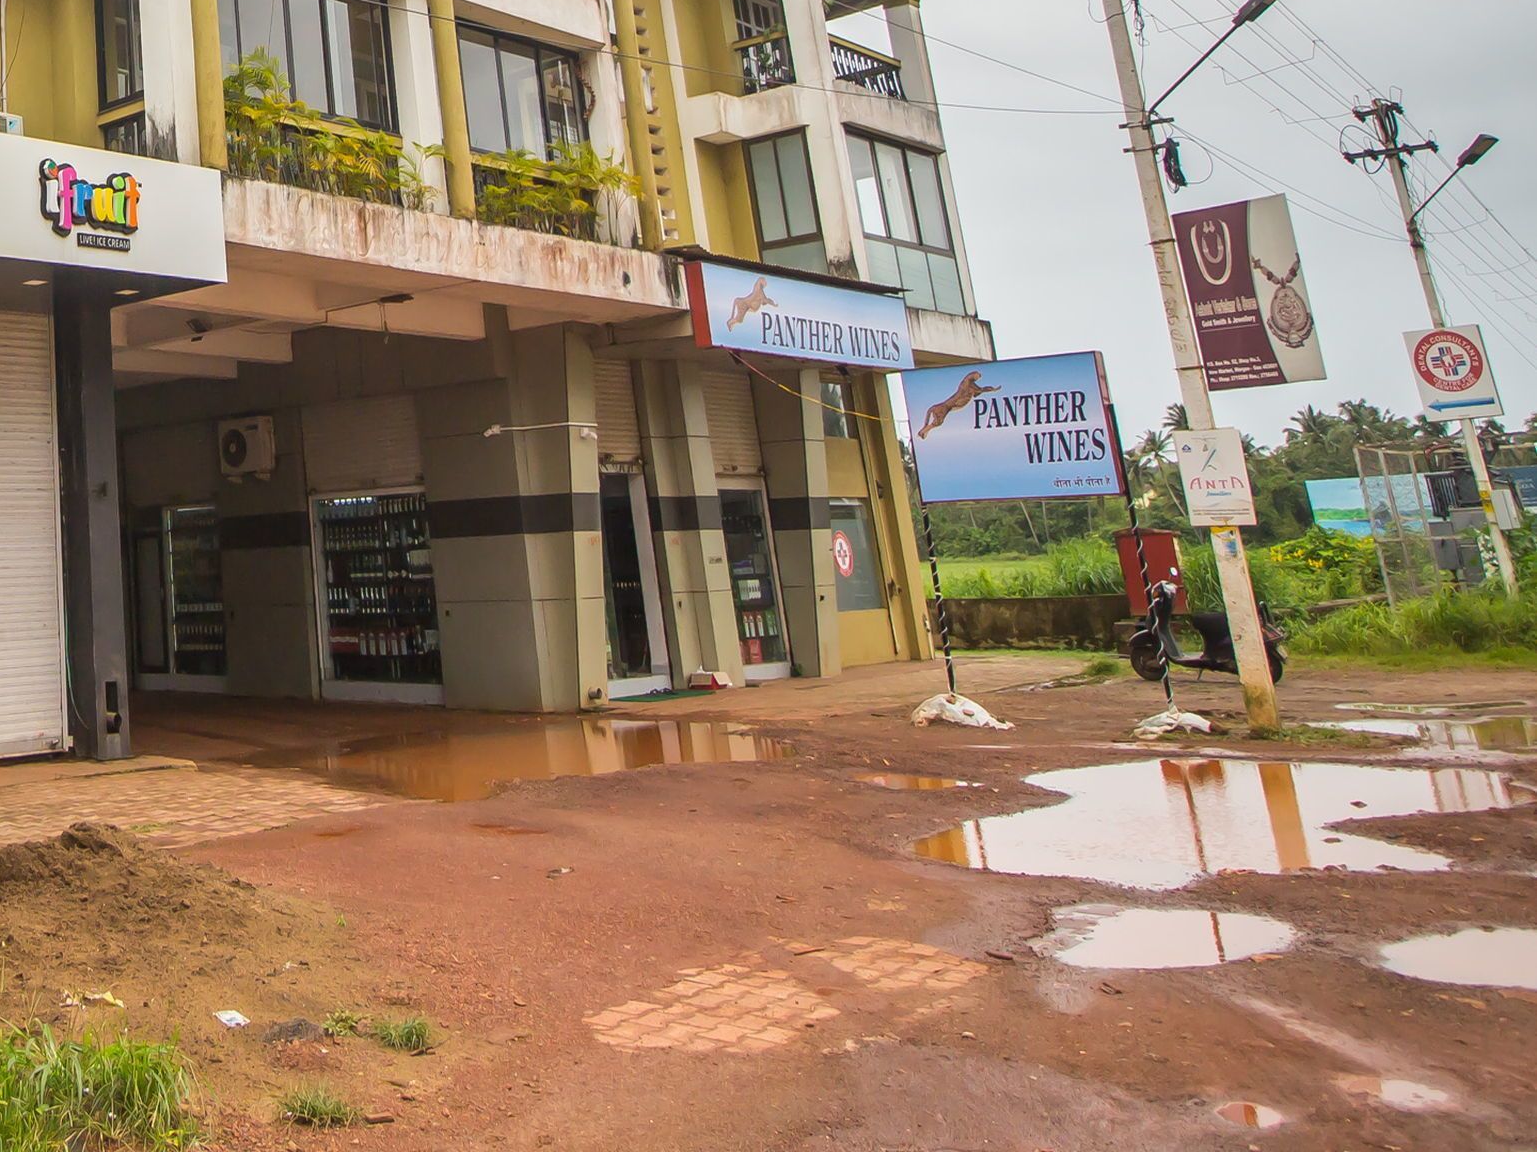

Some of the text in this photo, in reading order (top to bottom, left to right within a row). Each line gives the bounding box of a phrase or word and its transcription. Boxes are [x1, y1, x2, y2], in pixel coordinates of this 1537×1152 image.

[79, 234, 130, 249] LIVE! ICE CREAM
[761, 311, 901, 362] PANTHER WINES
[1417, 335, 1480, 372] DENTAL CONSULTANTS
[973, 390, 1106, 465] PANTHER WINES
[1189, 476, 1245, 490] ANTA
